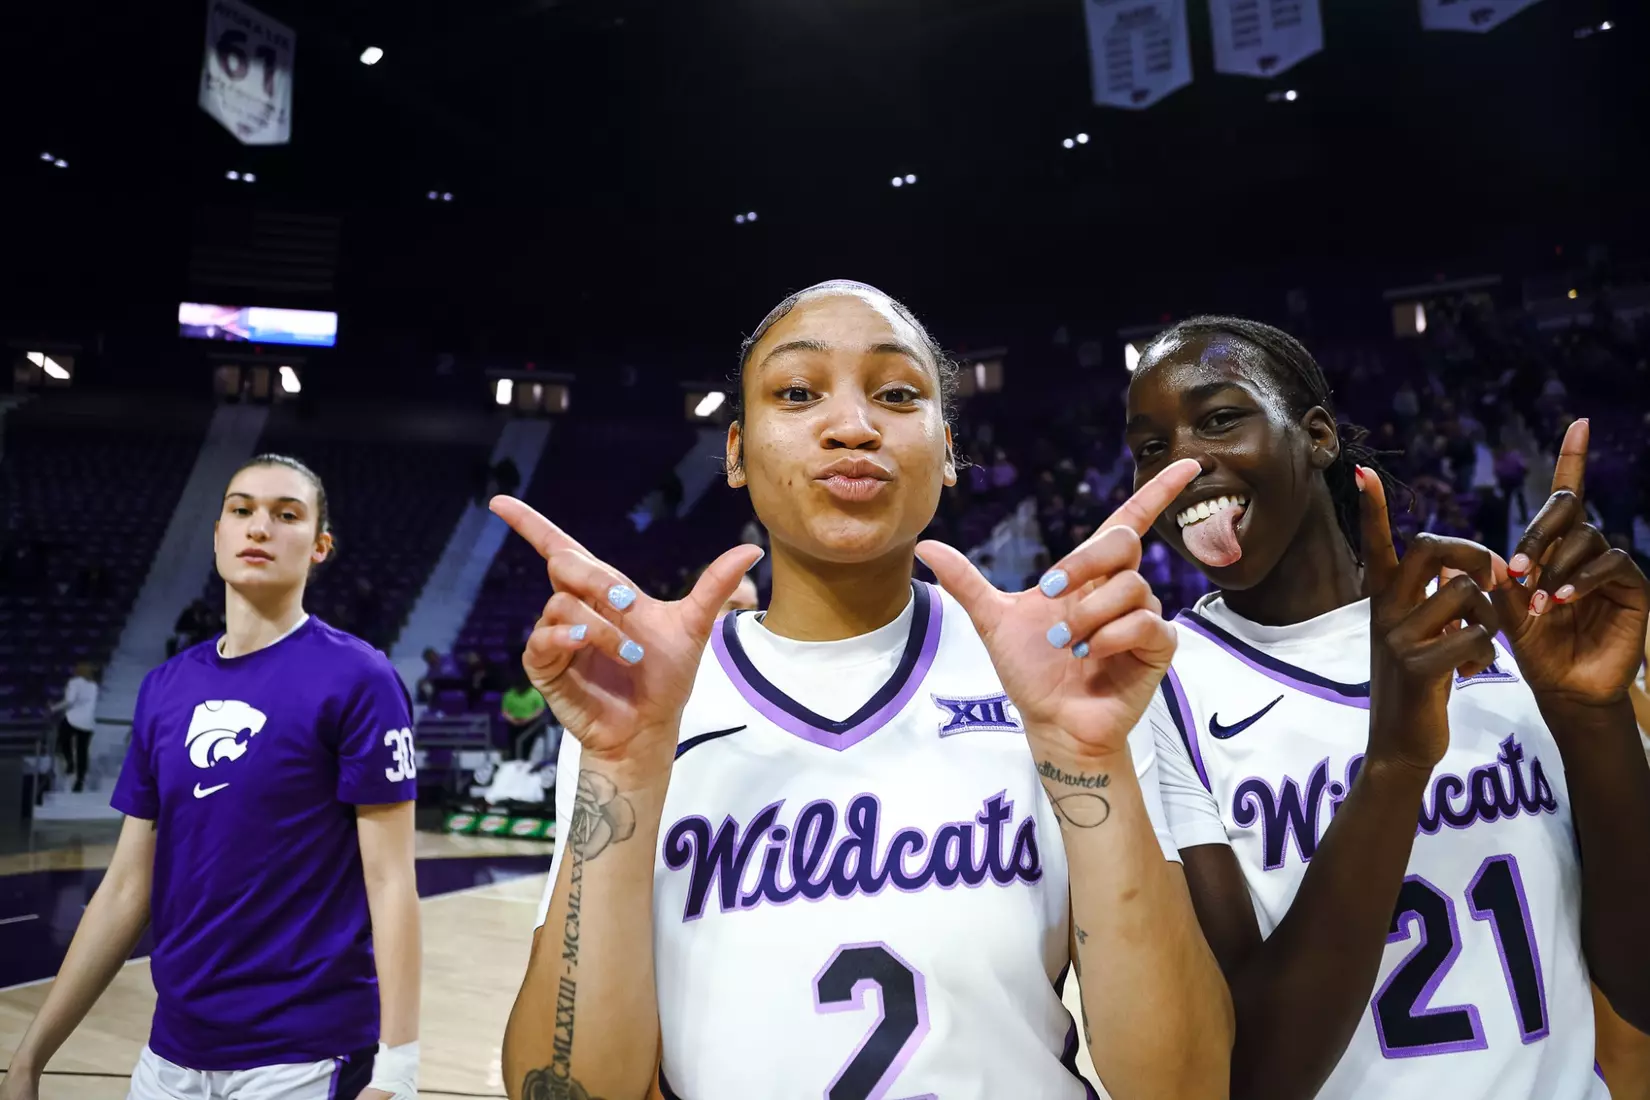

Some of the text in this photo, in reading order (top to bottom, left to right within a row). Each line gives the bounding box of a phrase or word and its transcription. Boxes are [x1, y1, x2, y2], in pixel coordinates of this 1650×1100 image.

[217, 29, 276, 98] 61
[384, 727, 416, 782] 30
[933, 691, 1022, 736] XII
[662, 788, 1044, 923] Wildcats
[1370, 853, 1550, 1059] 21
[811, 940, 938, 1100] 2
